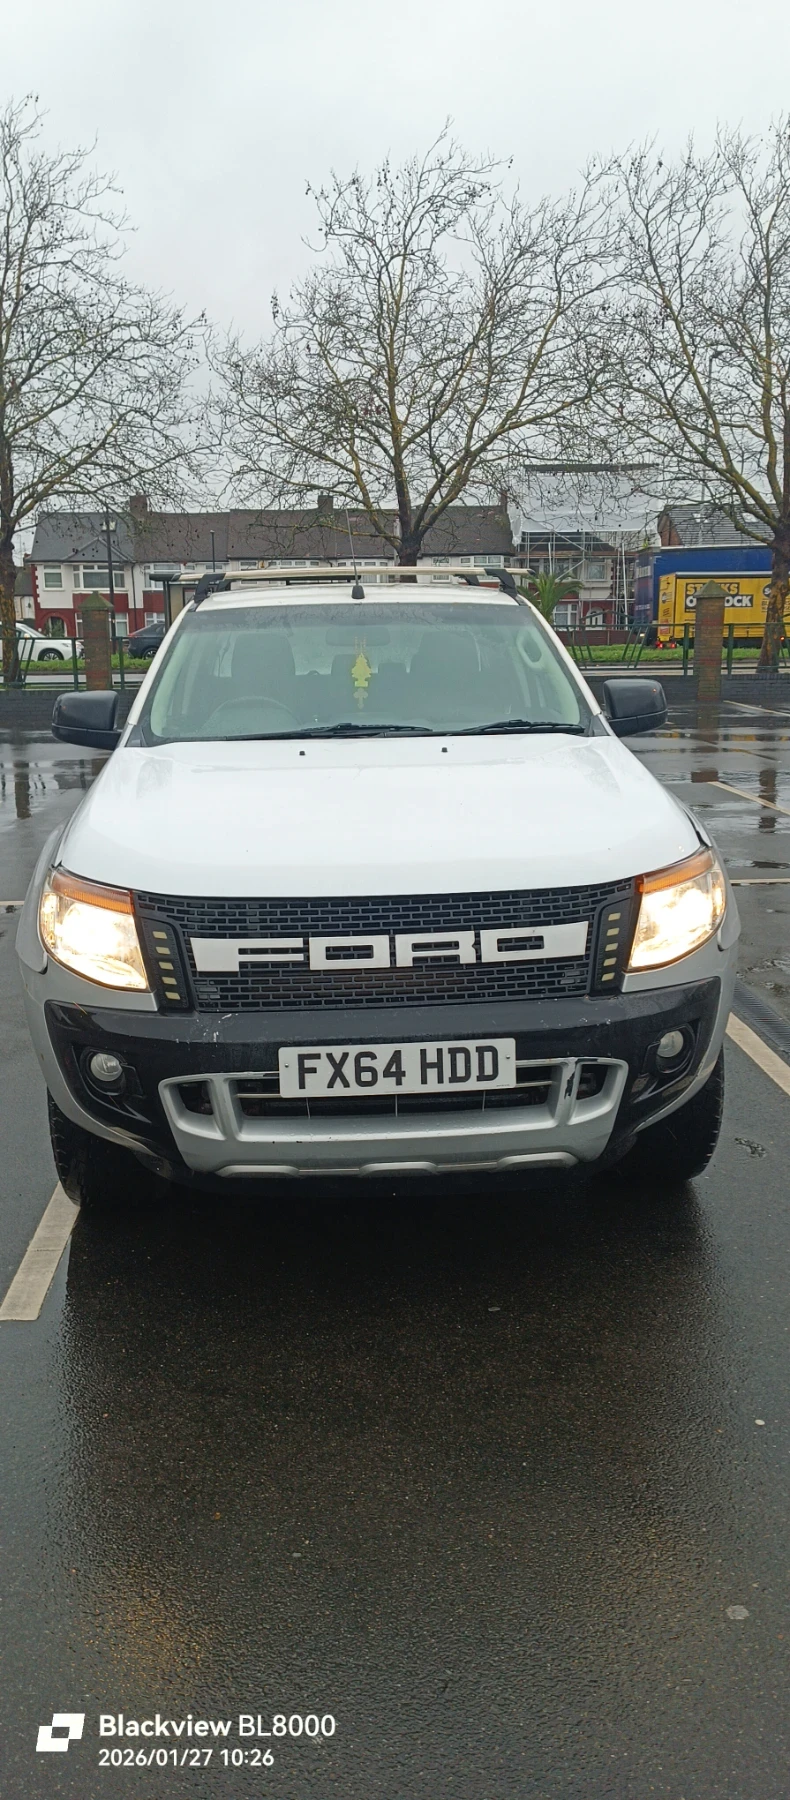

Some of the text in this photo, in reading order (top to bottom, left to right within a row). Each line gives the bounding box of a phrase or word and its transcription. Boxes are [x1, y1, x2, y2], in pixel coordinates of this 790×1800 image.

[686, 583, 739, 595] STKS
[190, 920, 589, 972] FORD
[297, 1045, 499, 1090] FX64 HDD
